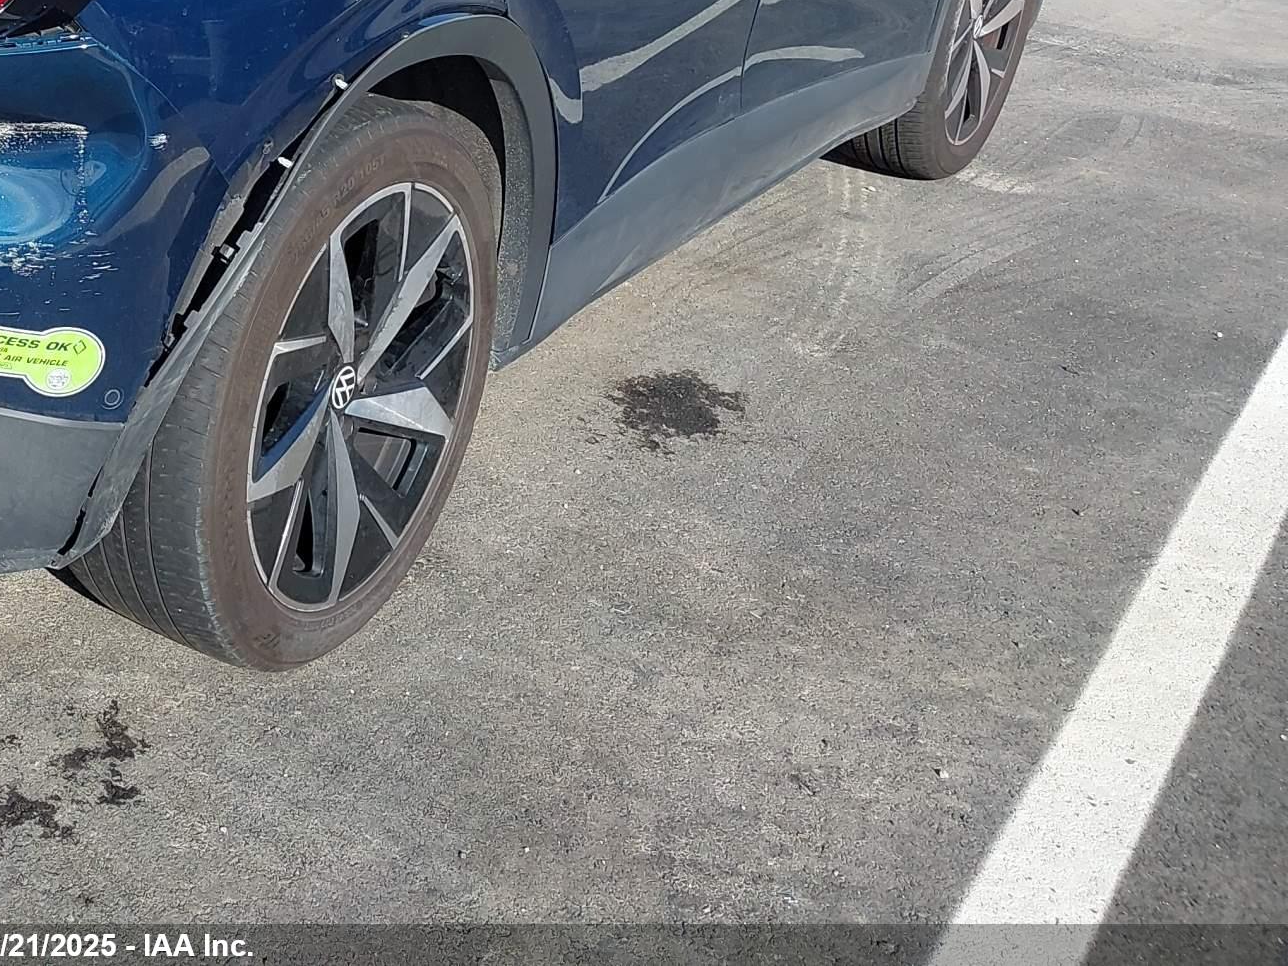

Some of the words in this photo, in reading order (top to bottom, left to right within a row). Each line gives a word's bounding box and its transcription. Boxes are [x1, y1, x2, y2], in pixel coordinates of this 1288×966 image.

[46, 341, 72, 352] OK
[4, 353, 22, 362] AIR
[27, 357, 69, 367] VEHICLE
